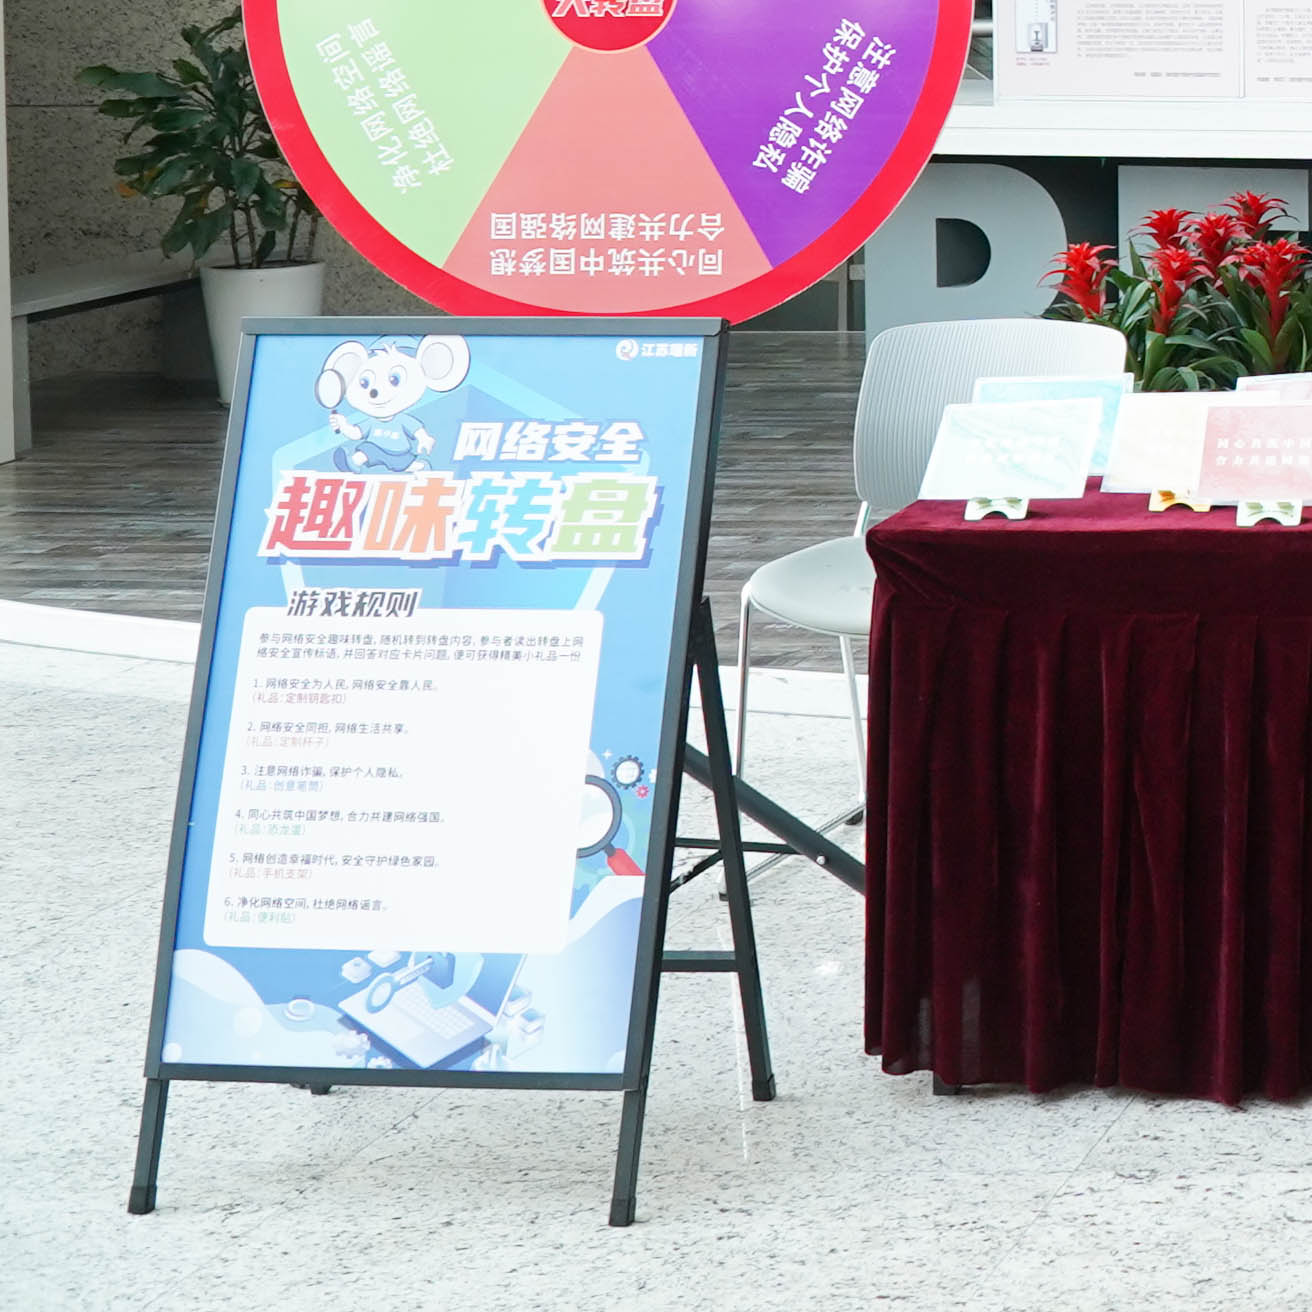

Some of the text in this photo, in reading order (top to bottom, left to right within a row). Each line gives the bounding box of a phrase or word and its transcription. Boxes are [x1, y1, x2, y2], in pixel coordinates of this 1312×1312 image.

[316, 31, 424, 194] 净化网络空间
[349, 15, 456, 178] 杜绝网络谣言
[750, 17, 867, 175] 保护个人隐私
[780, 35, 899, 196] 注意网络诈骗
[490, 211, 726, 242] 合力共建网络强国
[490, 246, 725, 276] 同心共筑中国梦想
[454, 421, 644, 463] 网络安全
[258, 471, 656, 559] 趣味转盘
[287, 590, 418, 618] 游戏规则
